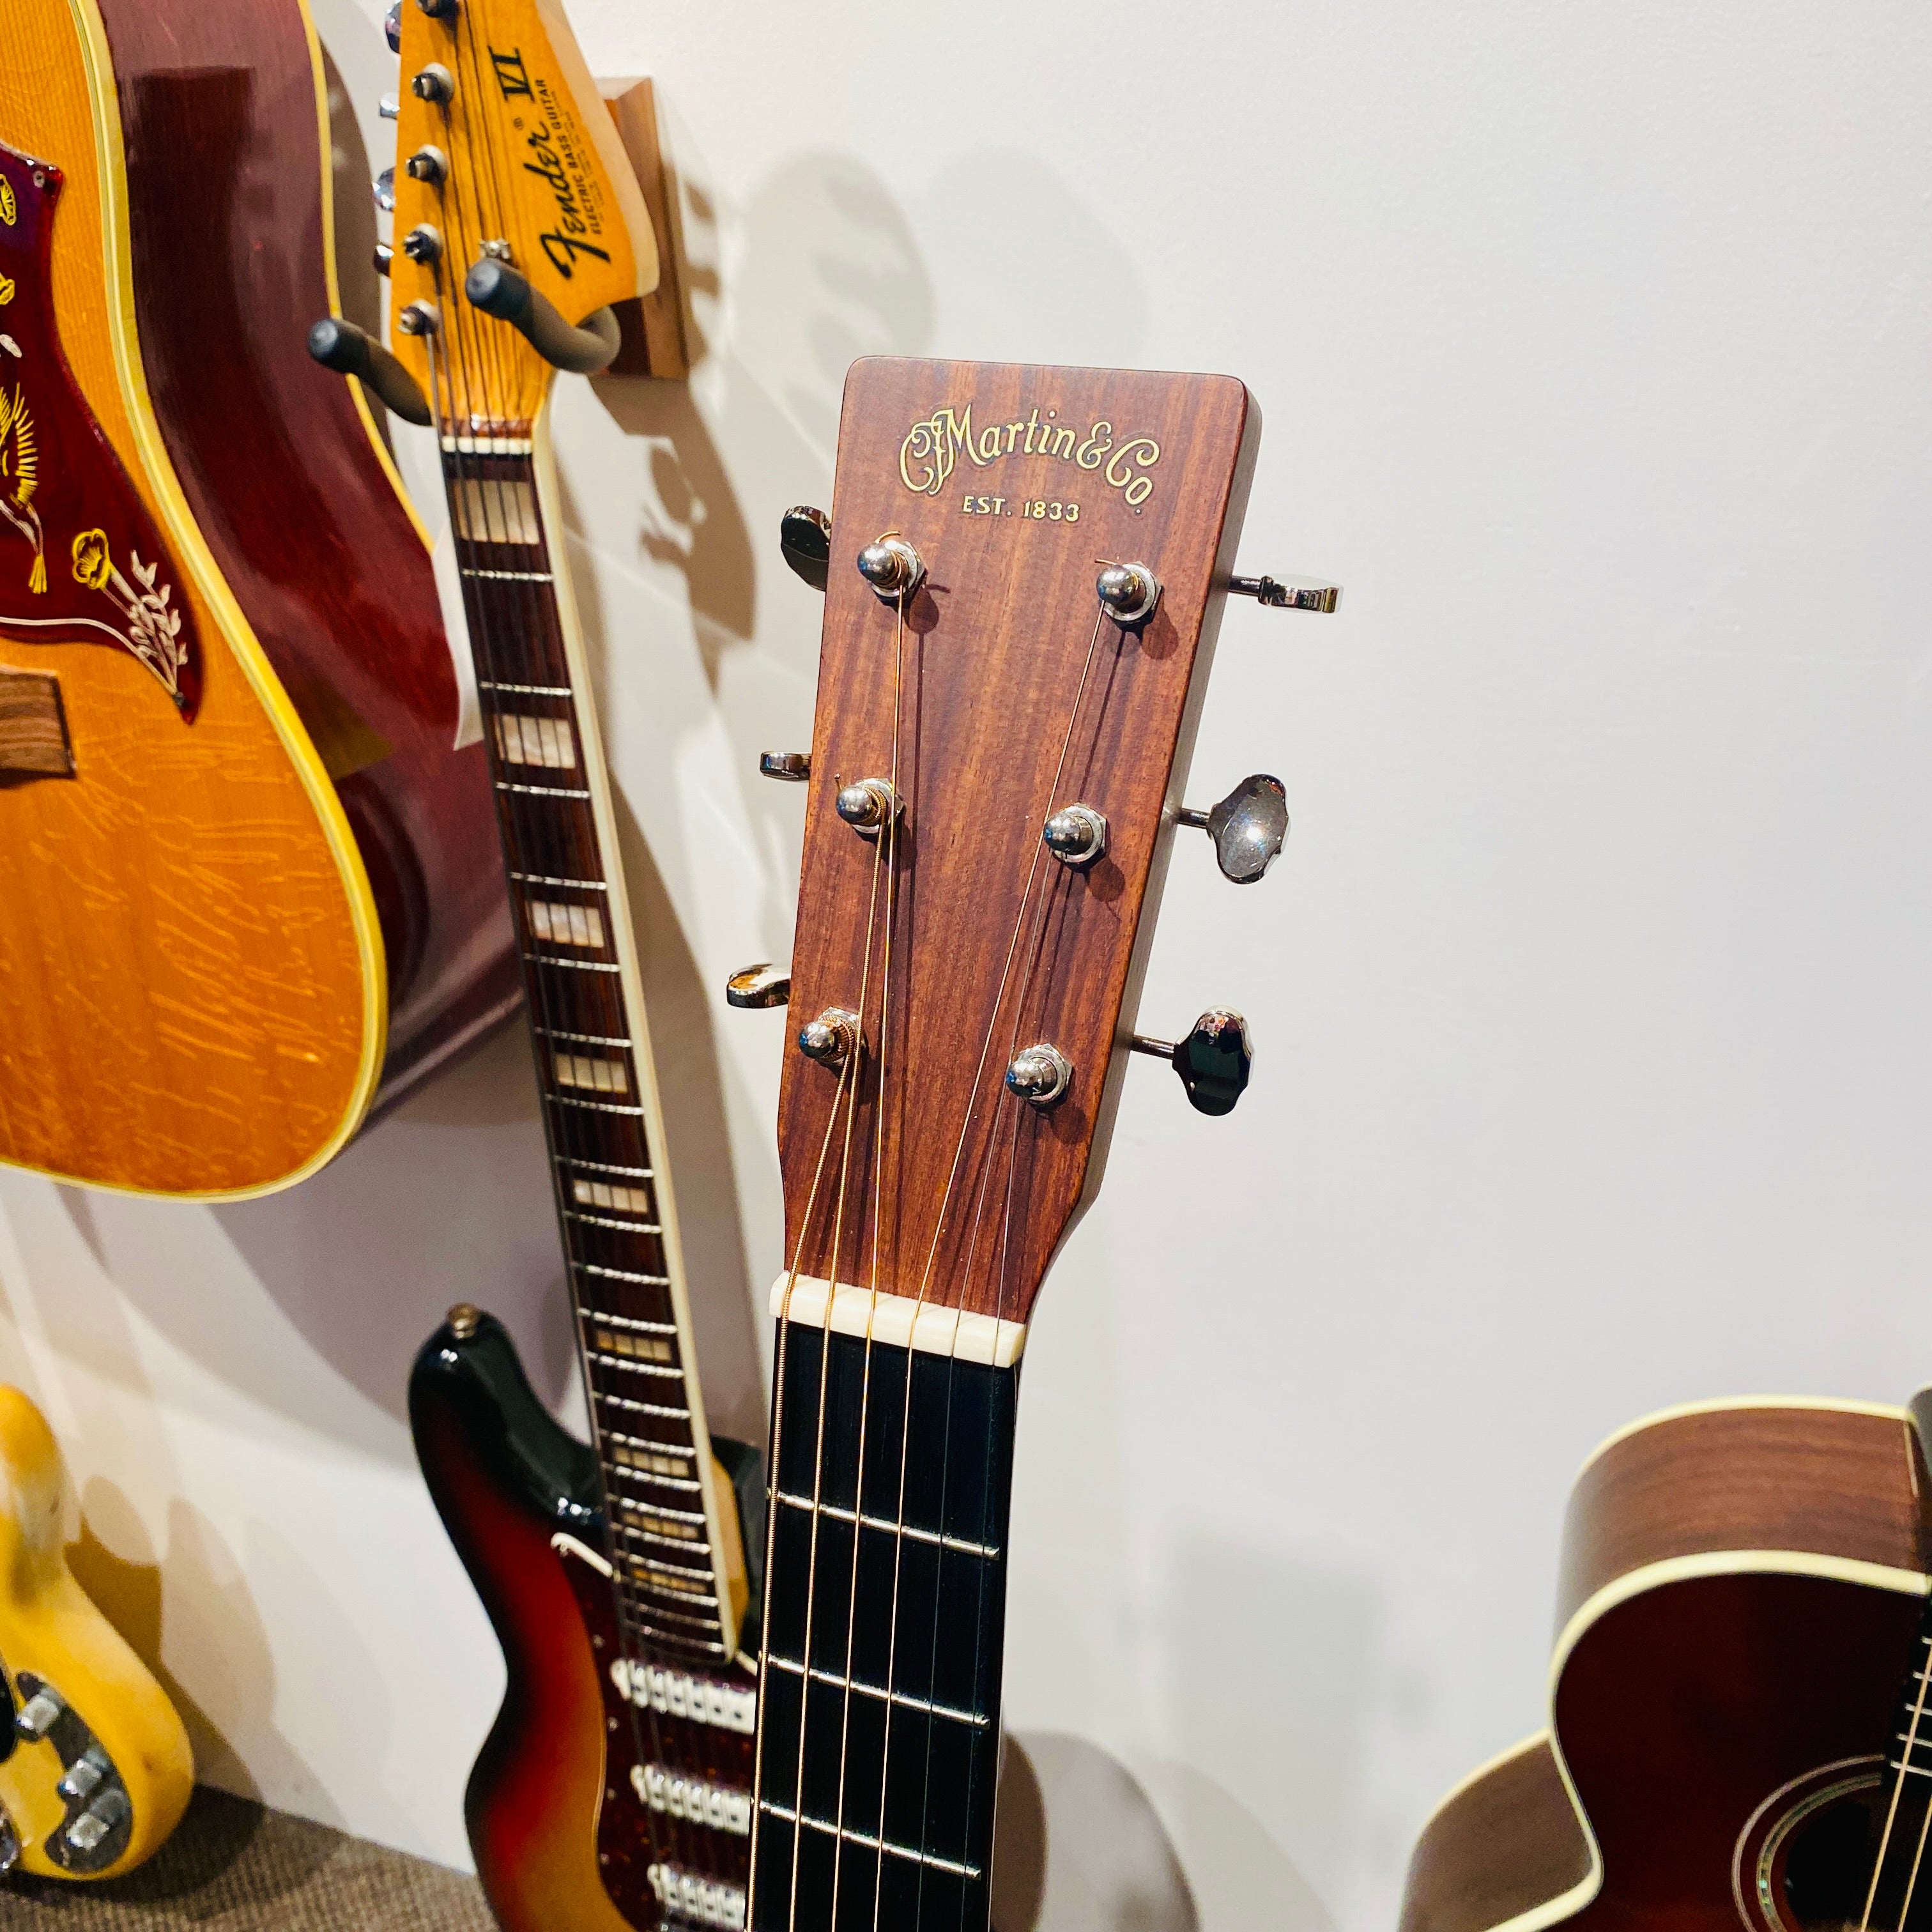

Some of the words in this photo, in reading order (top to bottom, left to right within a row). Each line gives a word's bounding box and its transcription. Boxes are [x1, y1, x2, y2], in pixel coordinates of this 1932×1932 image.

[487, 45, 535, 103] VI
[535, 79, 561, 130] GUITAR
[559, 131, 578, 169] BASS
[523, 121, 611, 280] Fender
[572, 174, 602, 236] ELECTRIC
[963, 494, 1012, 516] EST.
[1023, 500, 1080, 523] 1833
